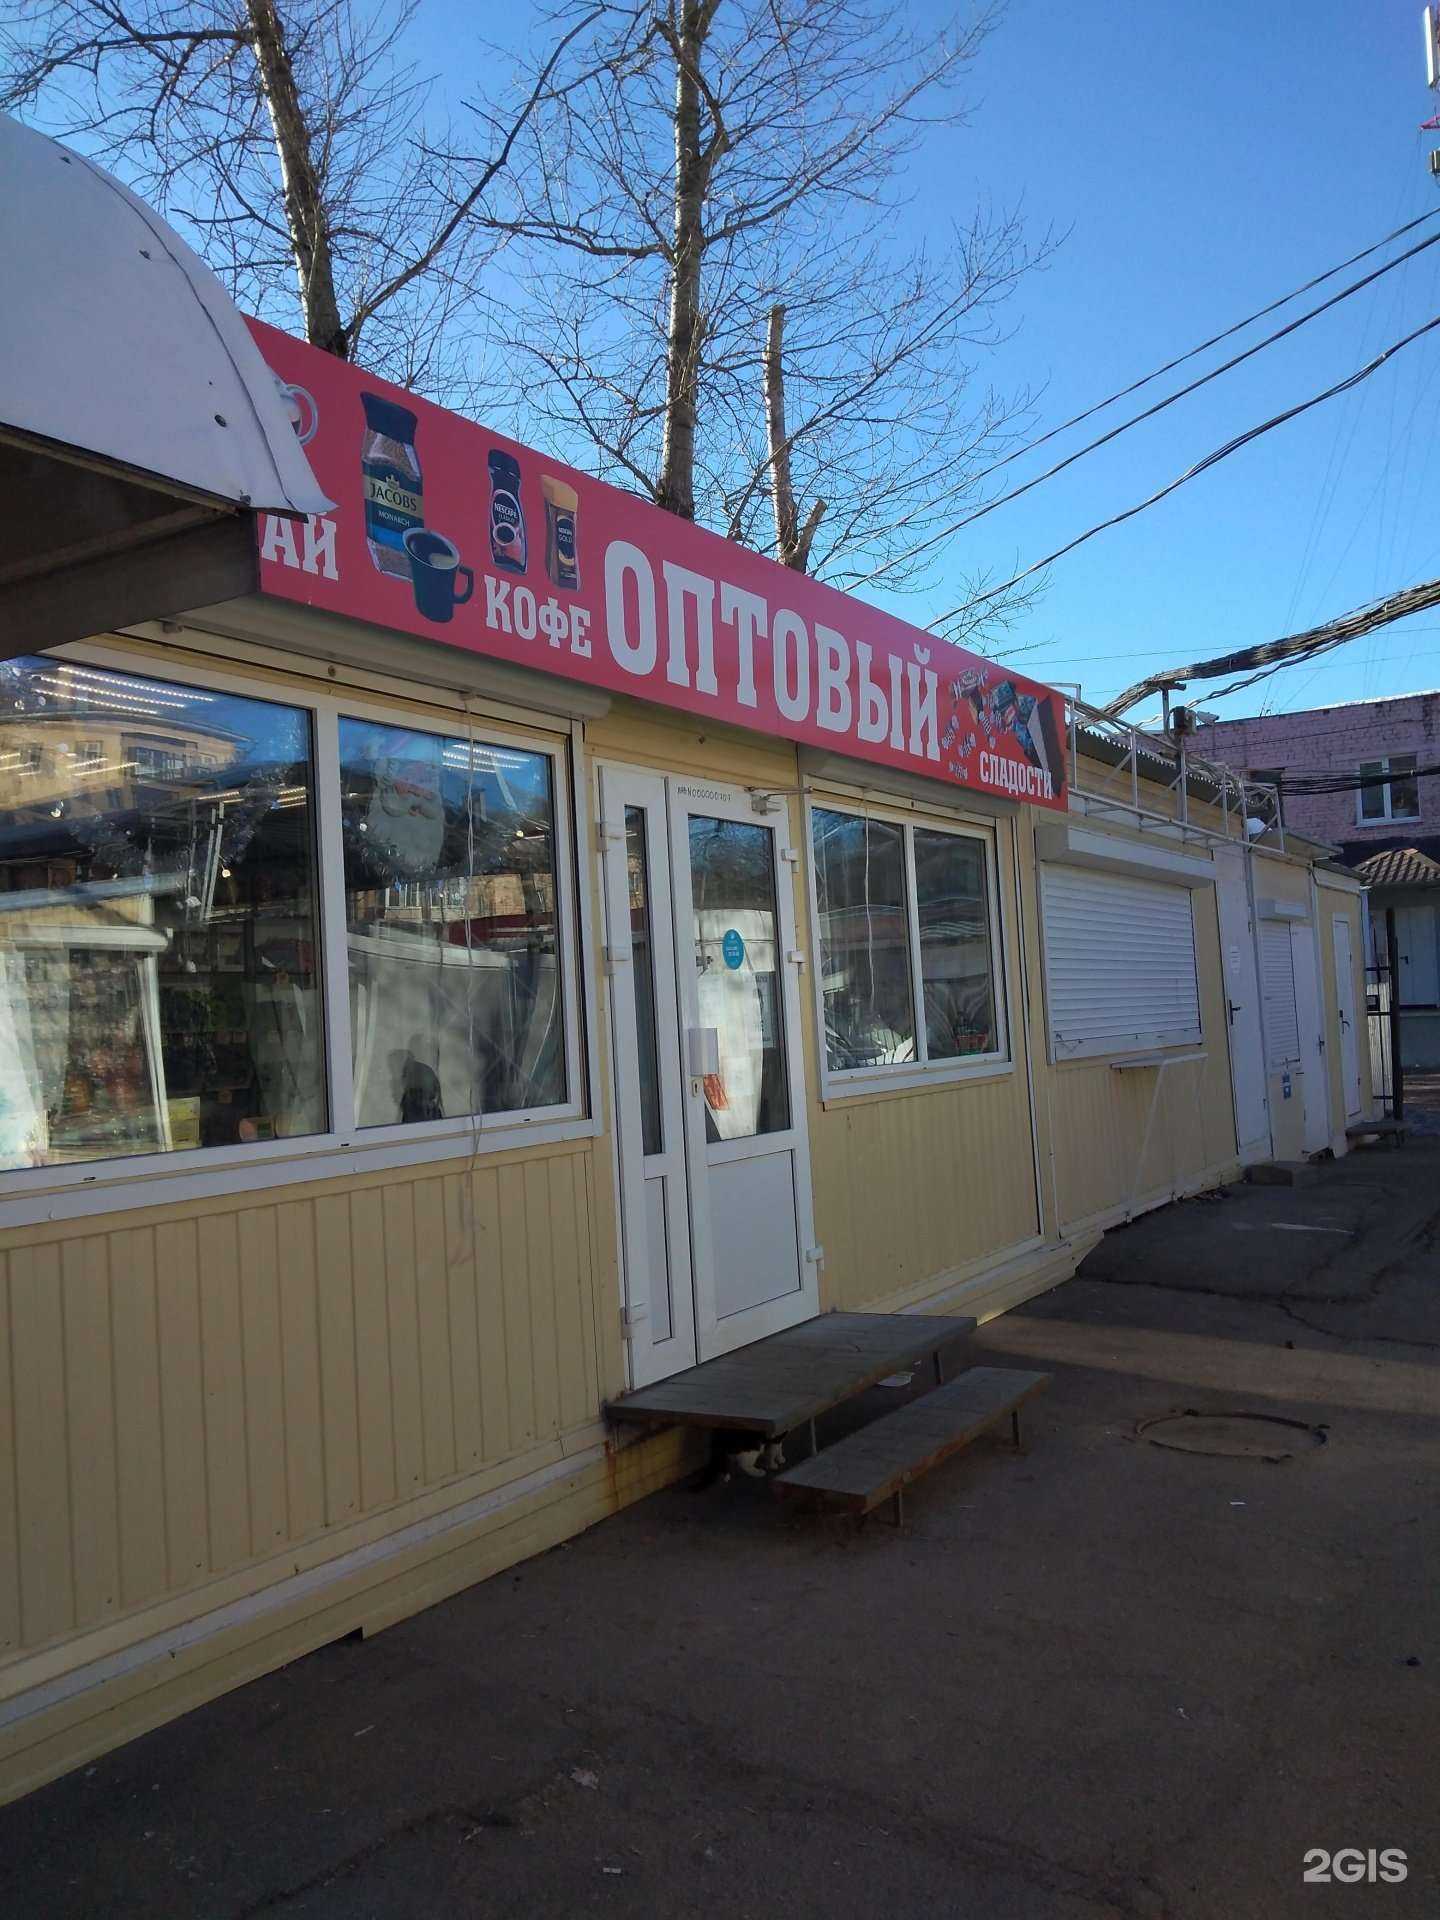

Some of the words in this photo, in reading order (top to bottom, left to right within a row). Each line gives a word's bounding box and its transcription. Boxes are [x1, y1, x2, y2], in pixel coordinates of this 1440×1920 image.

[370, 482, 417, 512] JACOBS
[484, 574, 592, 658] КОФЕ
[604, 540, 941, 762] ОПТОВЫЙ
[979, 751, 1053, 800] СЛАДОСТИ
